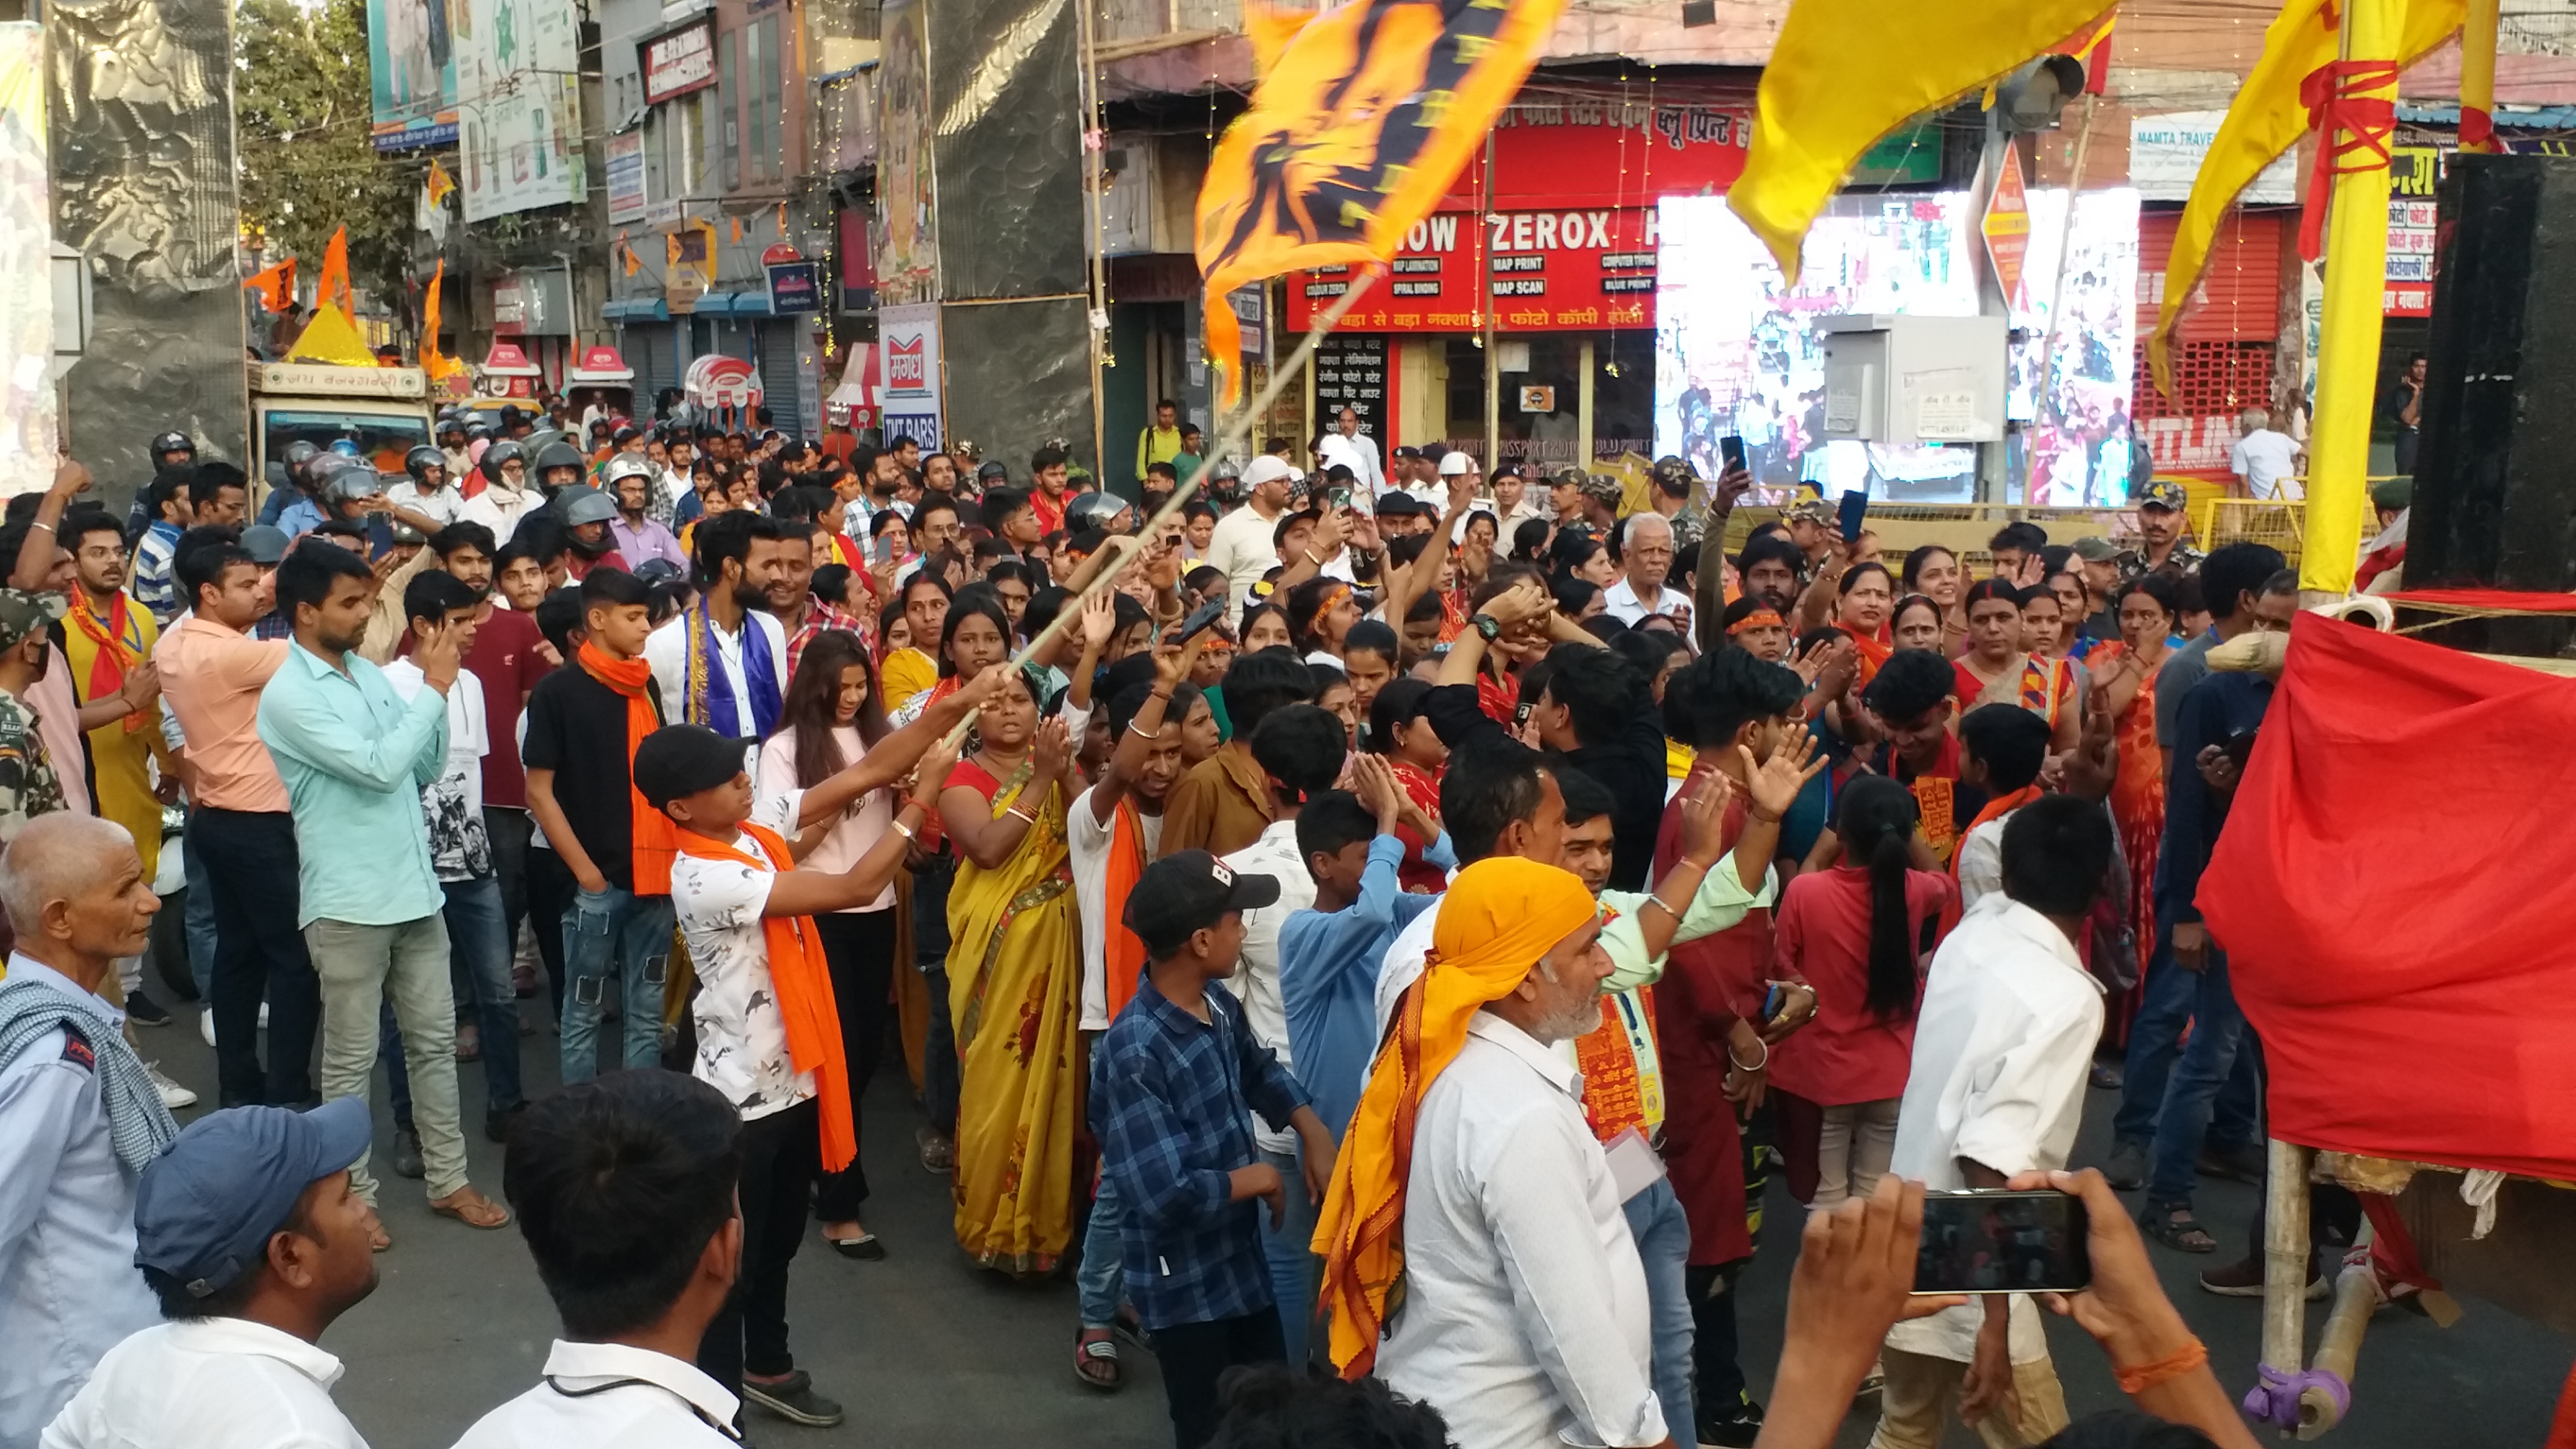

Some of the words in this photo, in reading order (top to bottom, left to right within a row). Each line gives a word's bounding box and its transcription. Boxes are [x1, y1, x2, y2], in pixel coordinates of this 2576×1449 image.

[2138, 131, 2175, 144] MAMTA
[1491, 212, 1610, 252] ZEROX
[1493, 258, 1513, 271] MAP
[1514, 256, 1543, 271] PRINT
[1394, 282, 1414, 295] SPIRAL
[1493, 282, 1514, 295] MAP
[1516, 281, 1543, 295] SCAN
[1605, 280, 1626, 290] BLUE
[1627, 278, 1652, 290] PRINT
[1373, 309, 1388, 326] से
[1510, 308, 1549, 326] फोटो
[891, 353, 923, 380] मगध
[1342, 370, 1361, 383] फोटो
[1365, 370, 1381, 383] स्टेट
[1360, 389, 1381, 399] आउट
[906, 418, 936, 448] BARS
